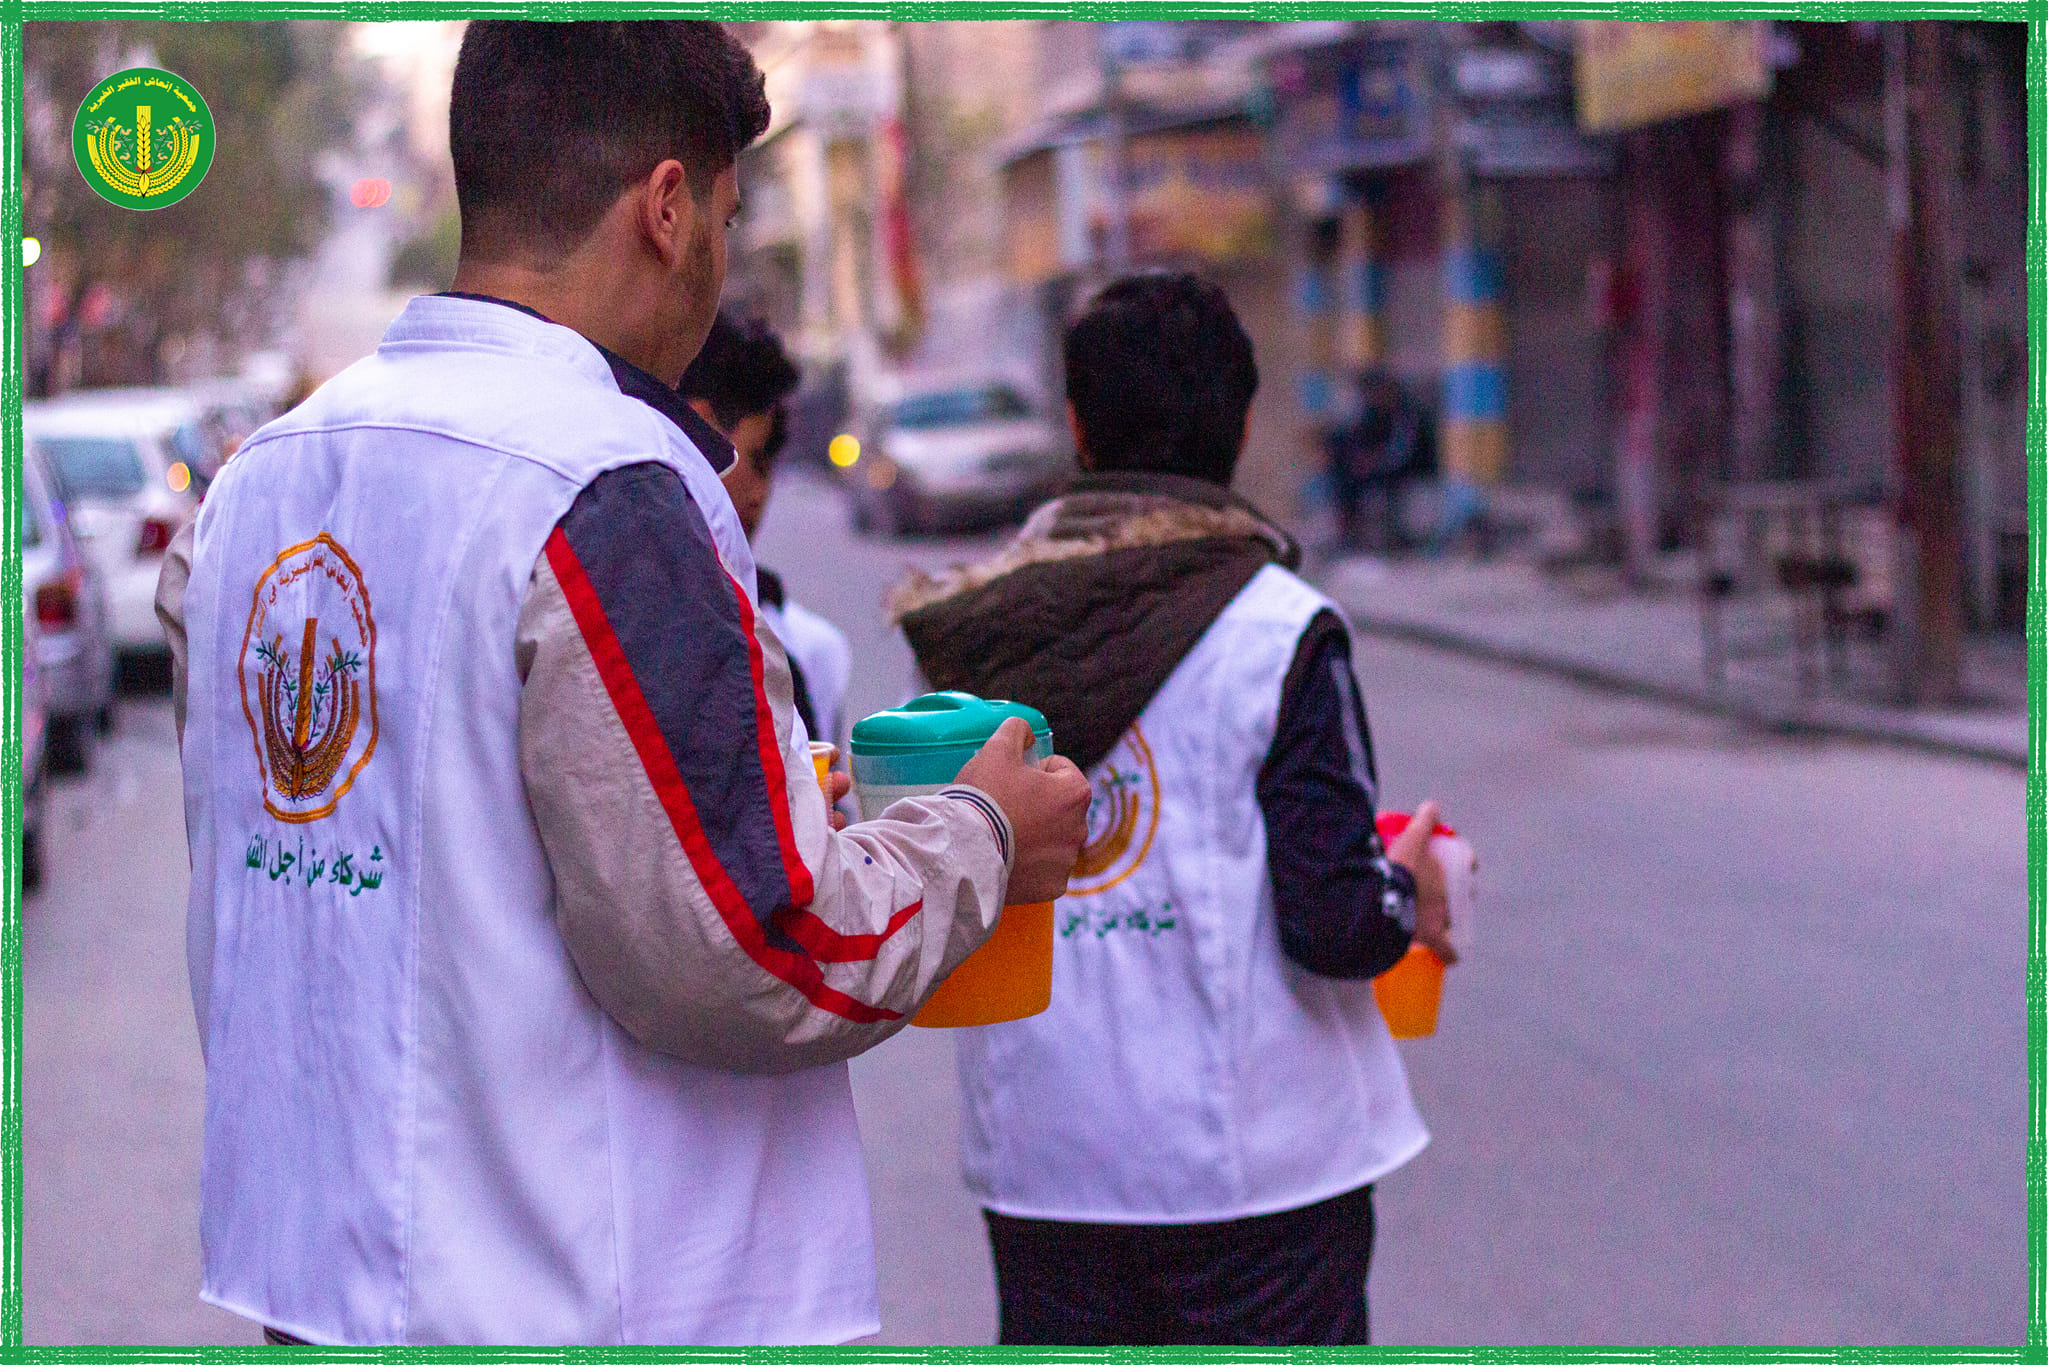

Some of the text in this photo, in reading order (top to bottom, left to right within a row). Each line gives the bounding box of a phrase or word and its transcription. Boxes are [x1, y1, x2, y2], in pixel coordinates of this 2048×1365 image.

[269, 835, 303, 886] أجل
[307, 848, 325, 888] من
[329, 845, 383, 896] شركاء
